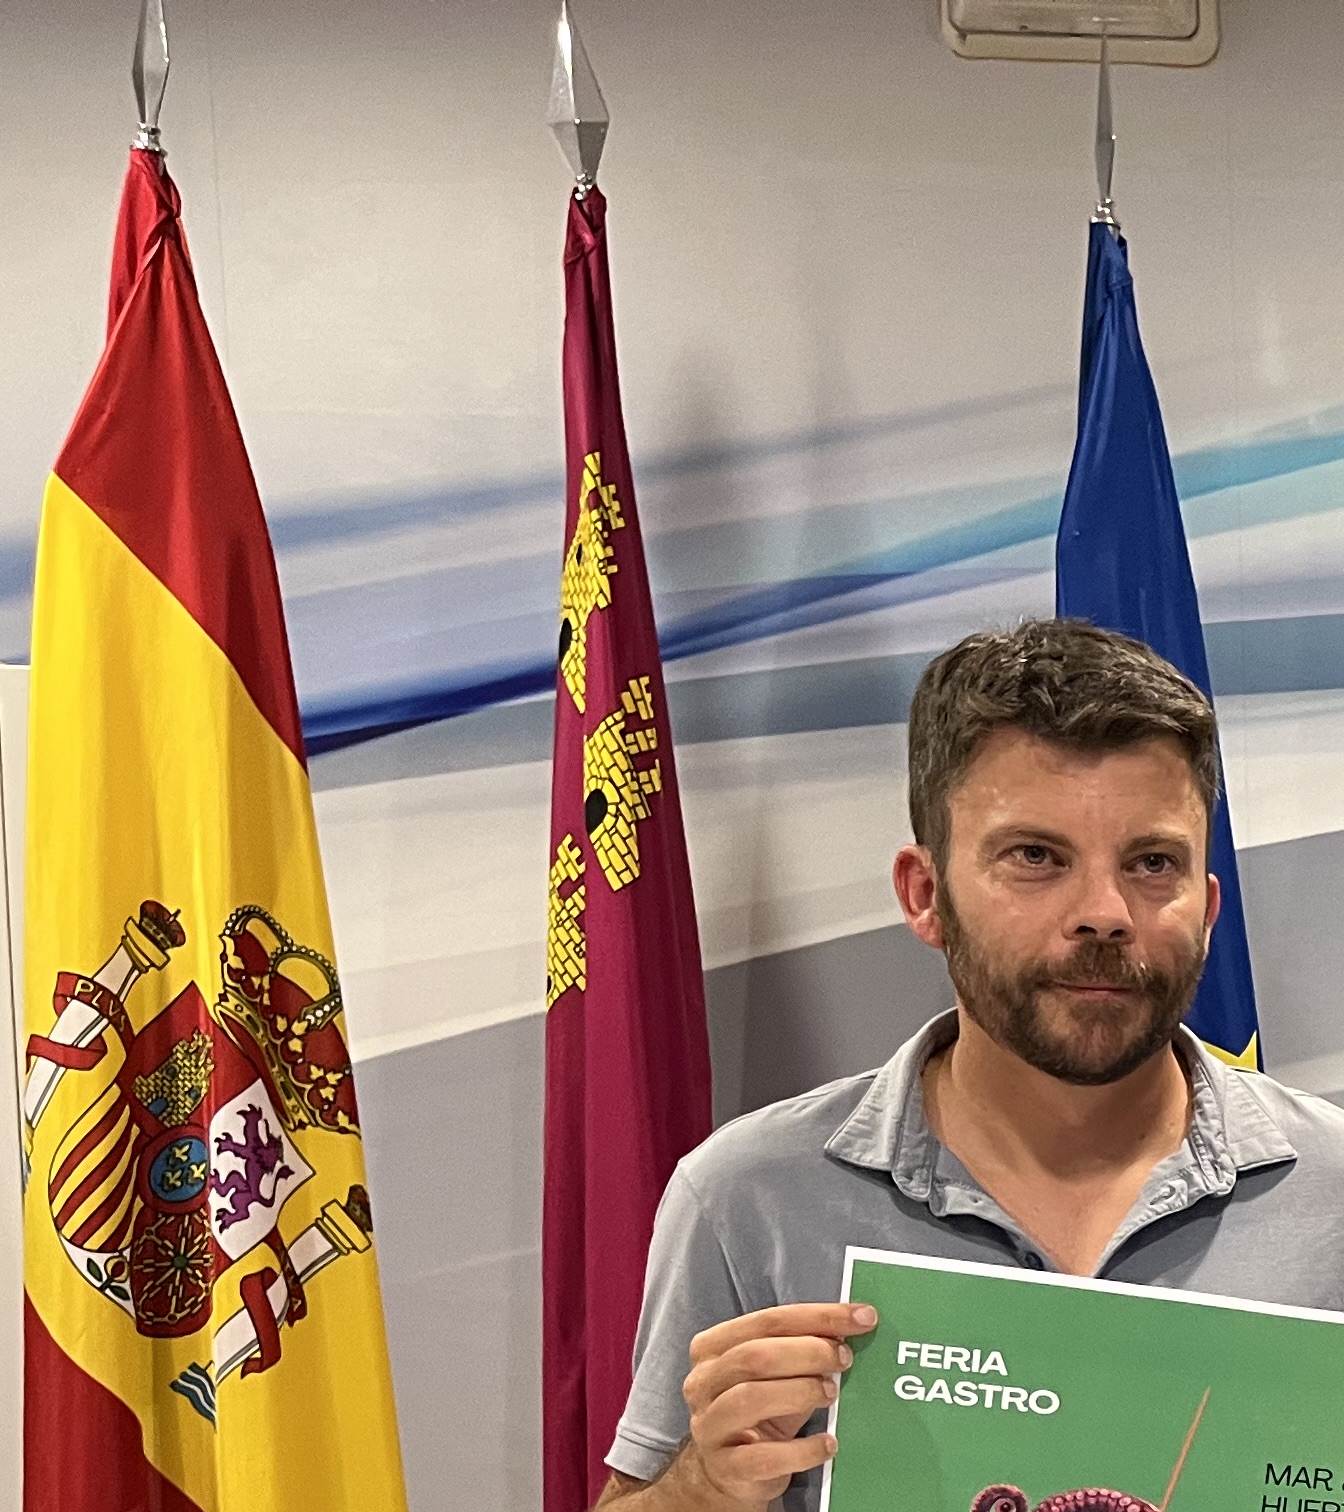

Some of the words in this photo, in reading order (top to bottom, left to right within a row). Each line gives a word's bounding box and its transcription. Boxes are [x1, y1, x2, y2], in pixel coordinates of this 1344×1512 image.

[897, 1340, 1009, 1377] FERIA
[893, 1375, 1060, 1416] GASTRO
[1263, 1462, 1335, 1493] MAR
